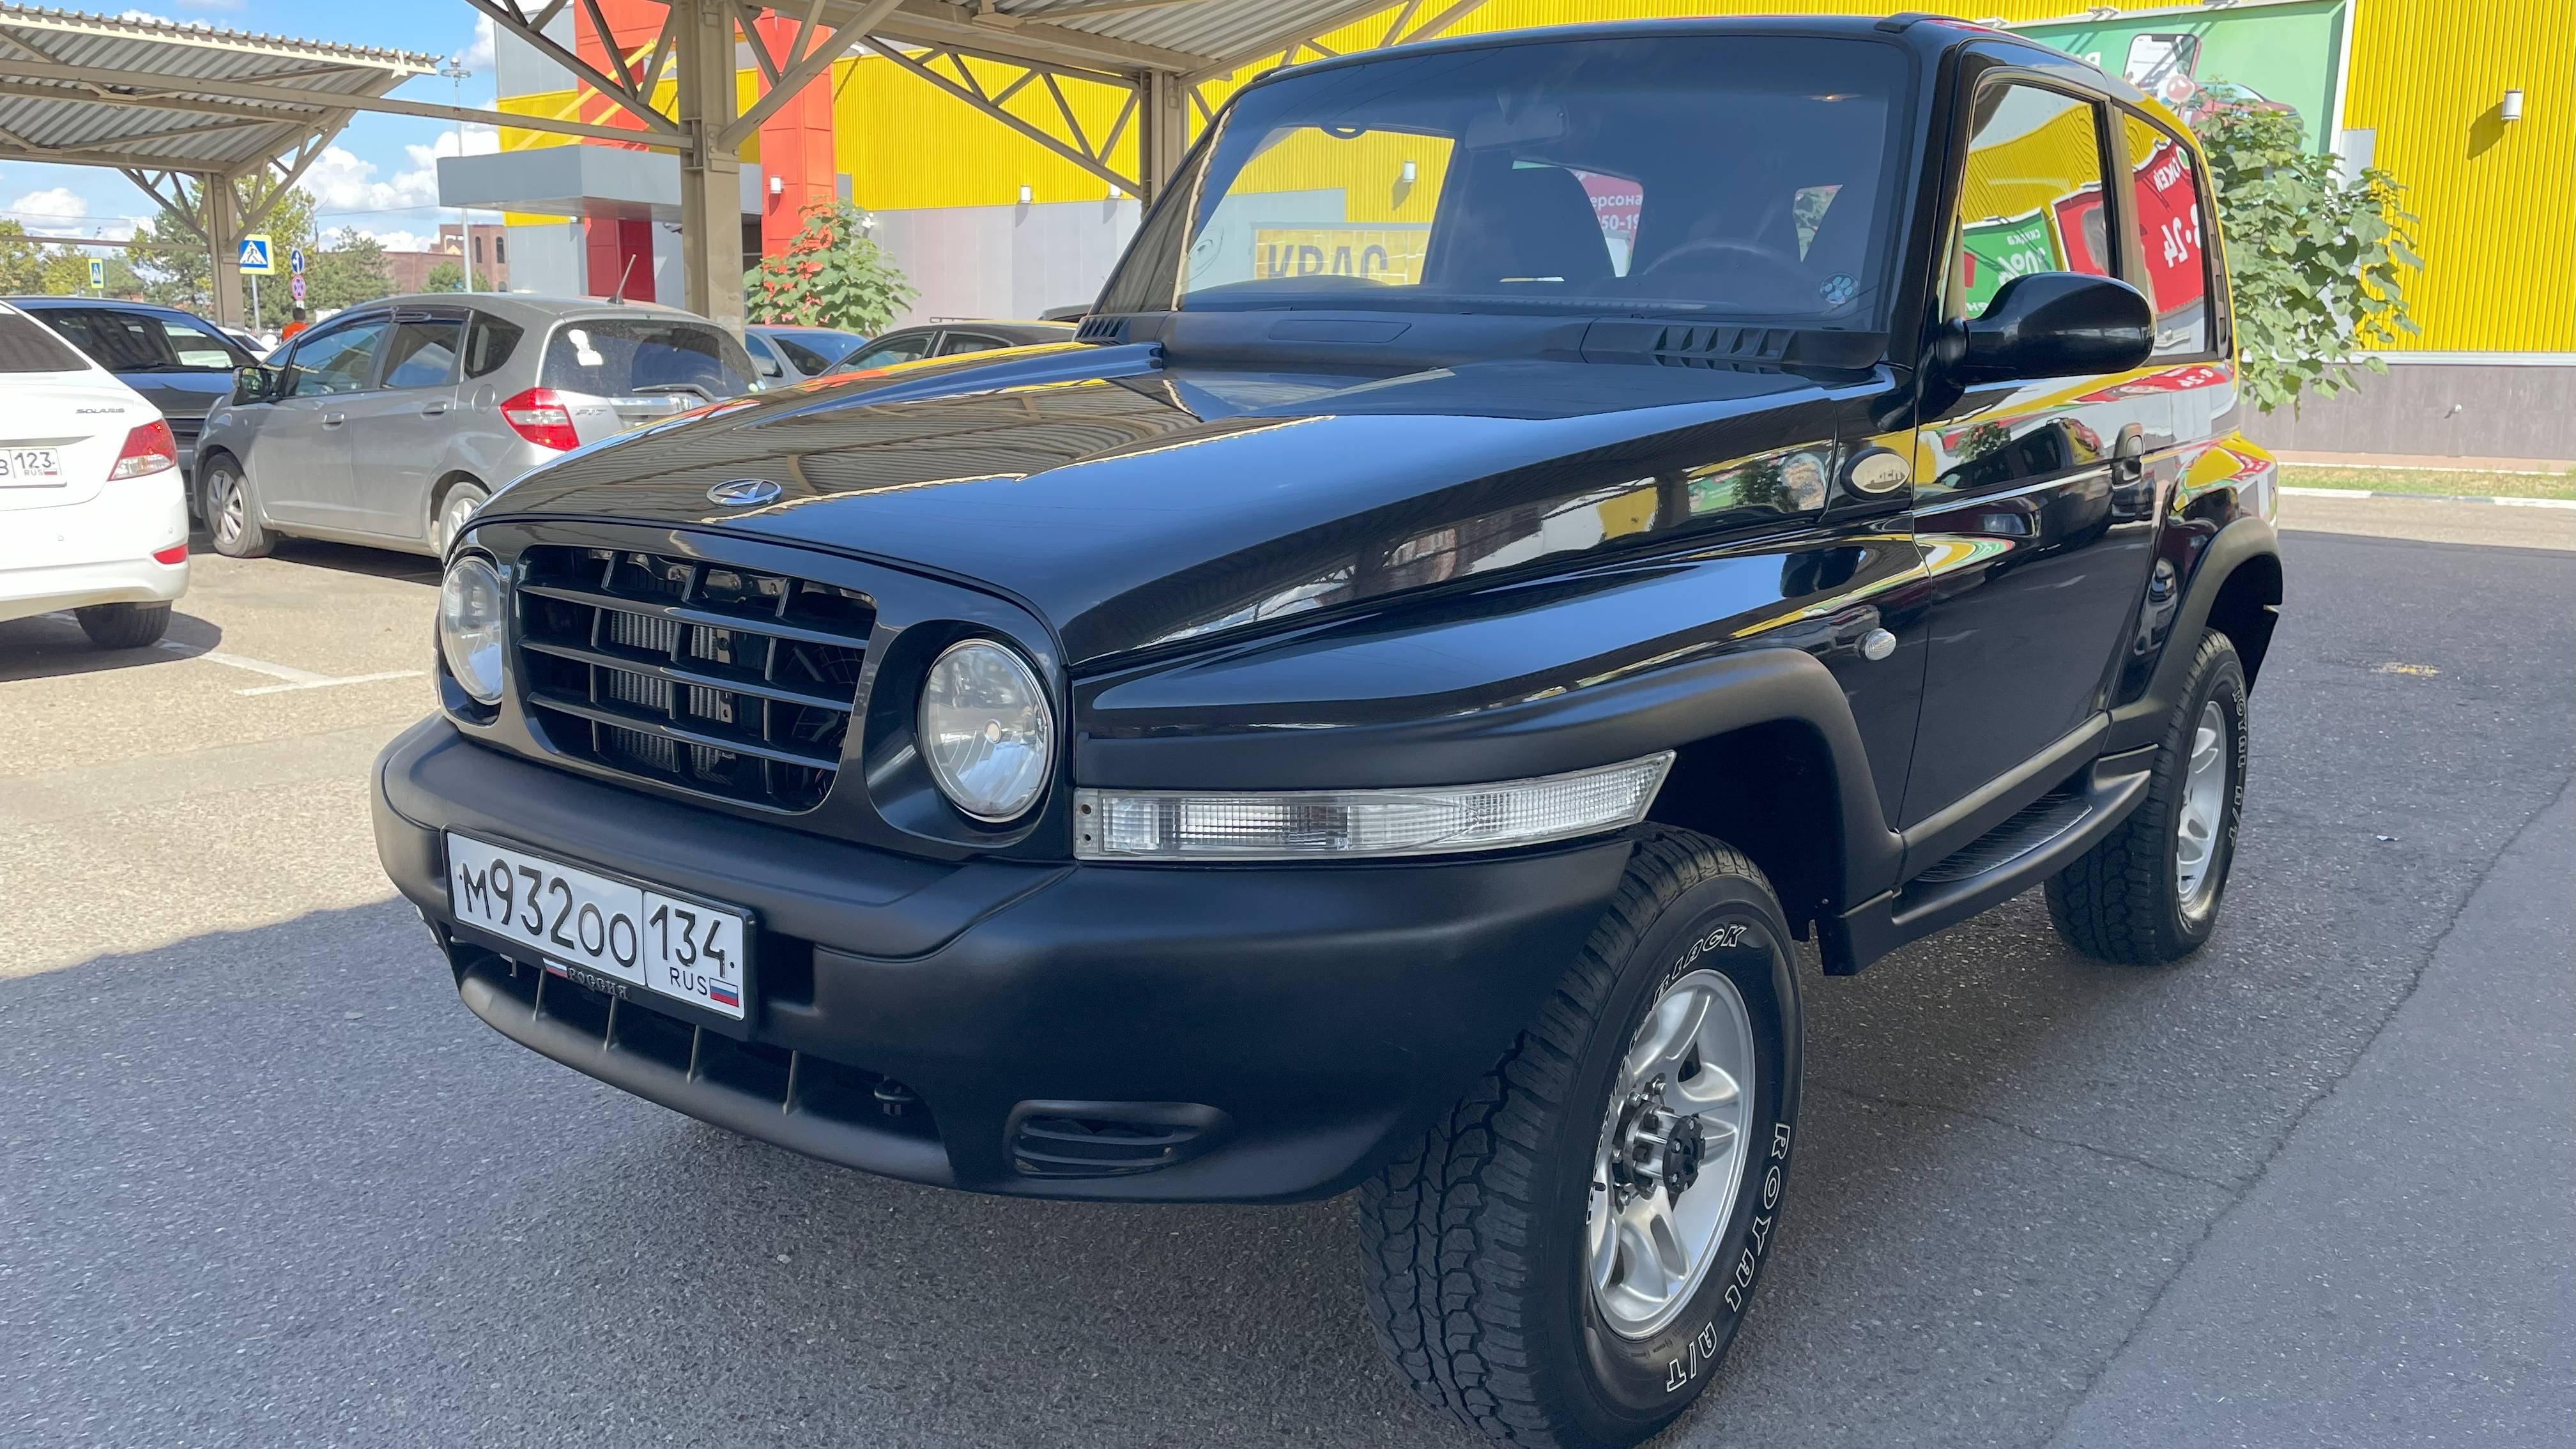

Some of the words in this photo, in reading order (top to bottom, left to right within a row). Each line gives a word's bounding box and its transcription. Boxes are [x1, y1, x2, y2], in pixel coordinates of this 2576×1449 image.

[14, 451, 51, 470] 123
[649, 904, 726, 979] 134
[670, 965, 708, 996] RUS
[1724, 1123, 1791, 1313] ROYAL
[1666, 1321, 1717, 1393] A/T
